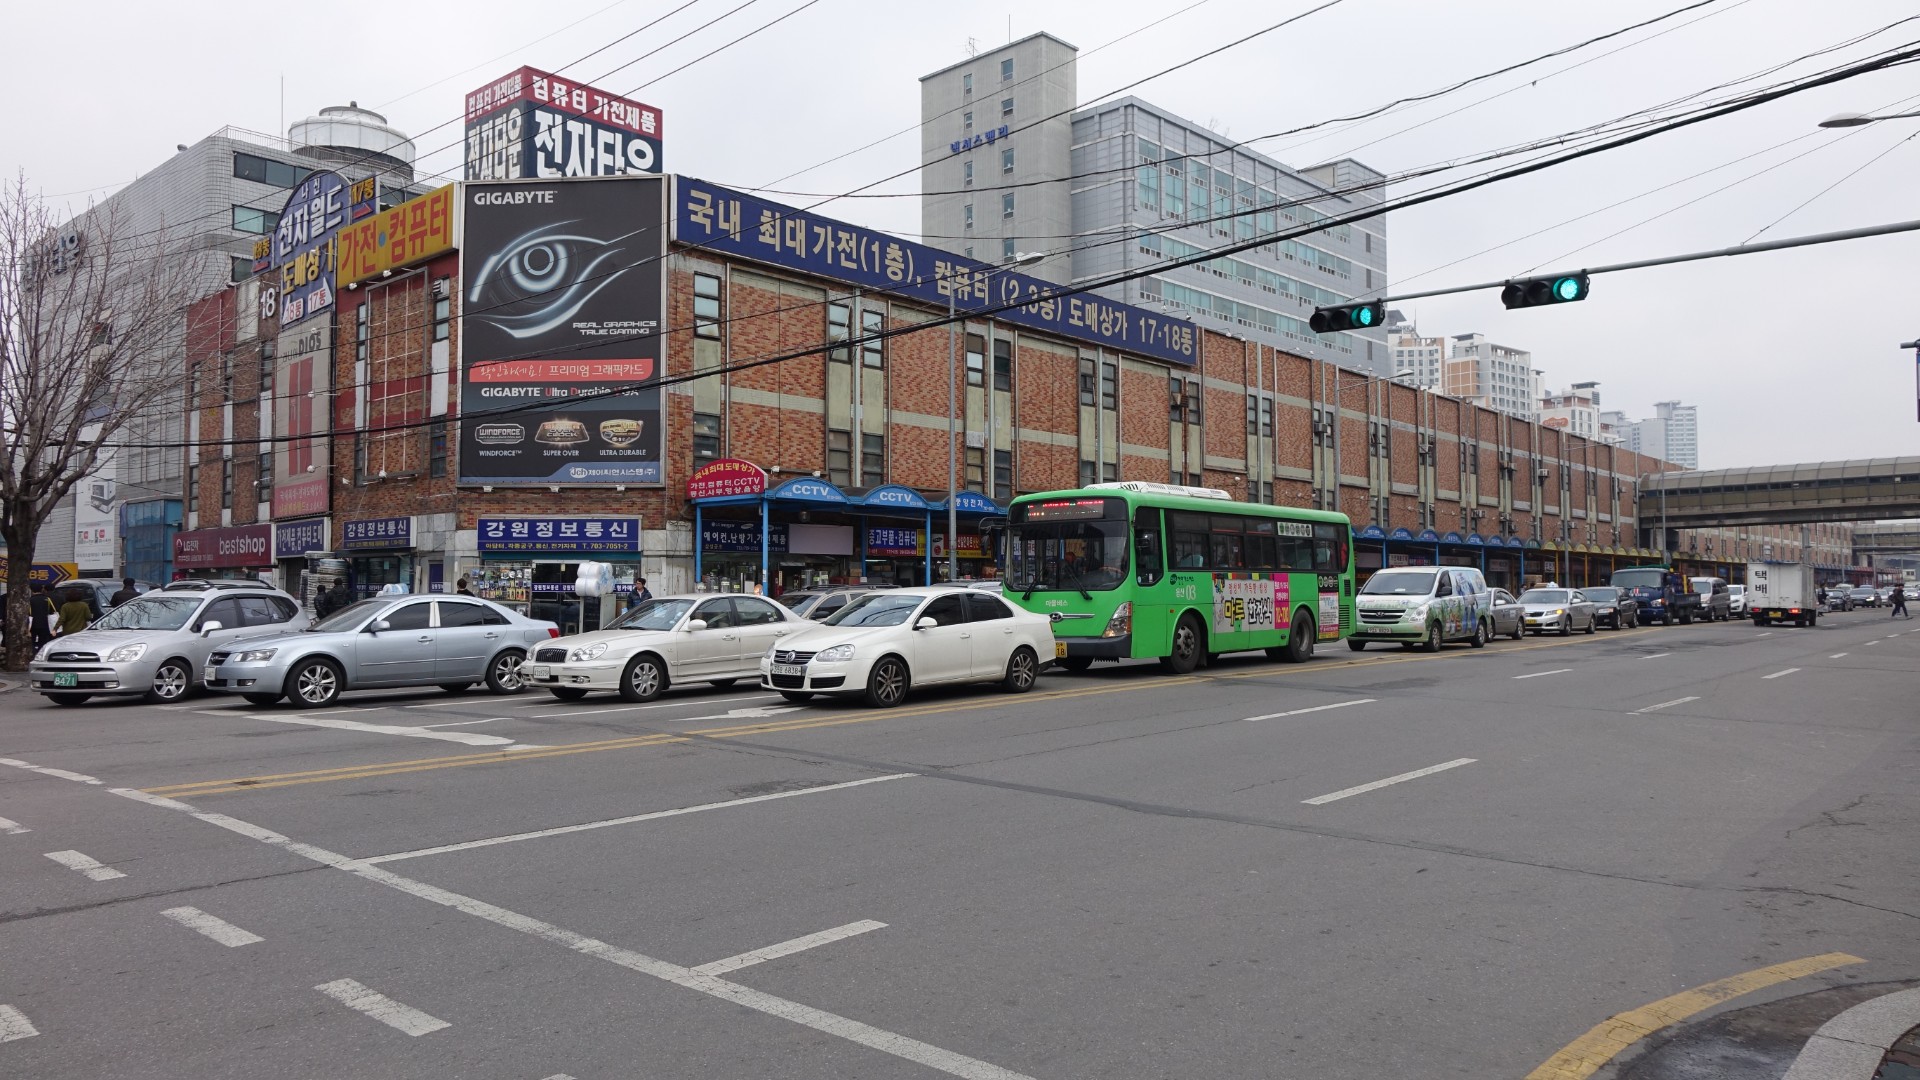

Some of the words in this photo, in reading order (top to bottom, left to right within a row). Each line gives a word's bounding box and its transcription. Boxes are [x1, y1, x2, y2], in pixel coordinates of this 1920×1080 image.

[533, 76, 587, 113] 컴퓨터
[594, 95, 656, 134] 가전제품
[473, 190, 554, 206] GIGABYTE
[278, 184, 343, 257] 전자월드
[282, 237, 334, 295] 도매상가
[687, 189, 741, 243] 국내
[935, 260, 990, 306] 컴퓨터
[1068, 297, 1128, 341] 도매상가
[260, 287, 276, 320] 18
[309, 288, 326, 311] 17동
[603, 320, 657, 328] GRAPHICS
[549, 365, 590, 378] 프리미엄
[591, 363, 645, 378] 그래픽카드
[481, 387, 541, 397] GIGABYTE
[545, 387, 568, 397] Ultra
[543, 449, 562, 457] SUPER
[562, 449, 580, 457] OVER
[792, 484, 829, 496] CCTV
[880, 491, 912, 503] CCTV
[347, 519, 407, 538] 강원정보통신
[486, 521, 628, 538] 강원정보통신
[219, 535, 266, 557] bestshop
[1754, 570, 1768, 594] 택배
[1224, 596, 1245, 627] 마루
